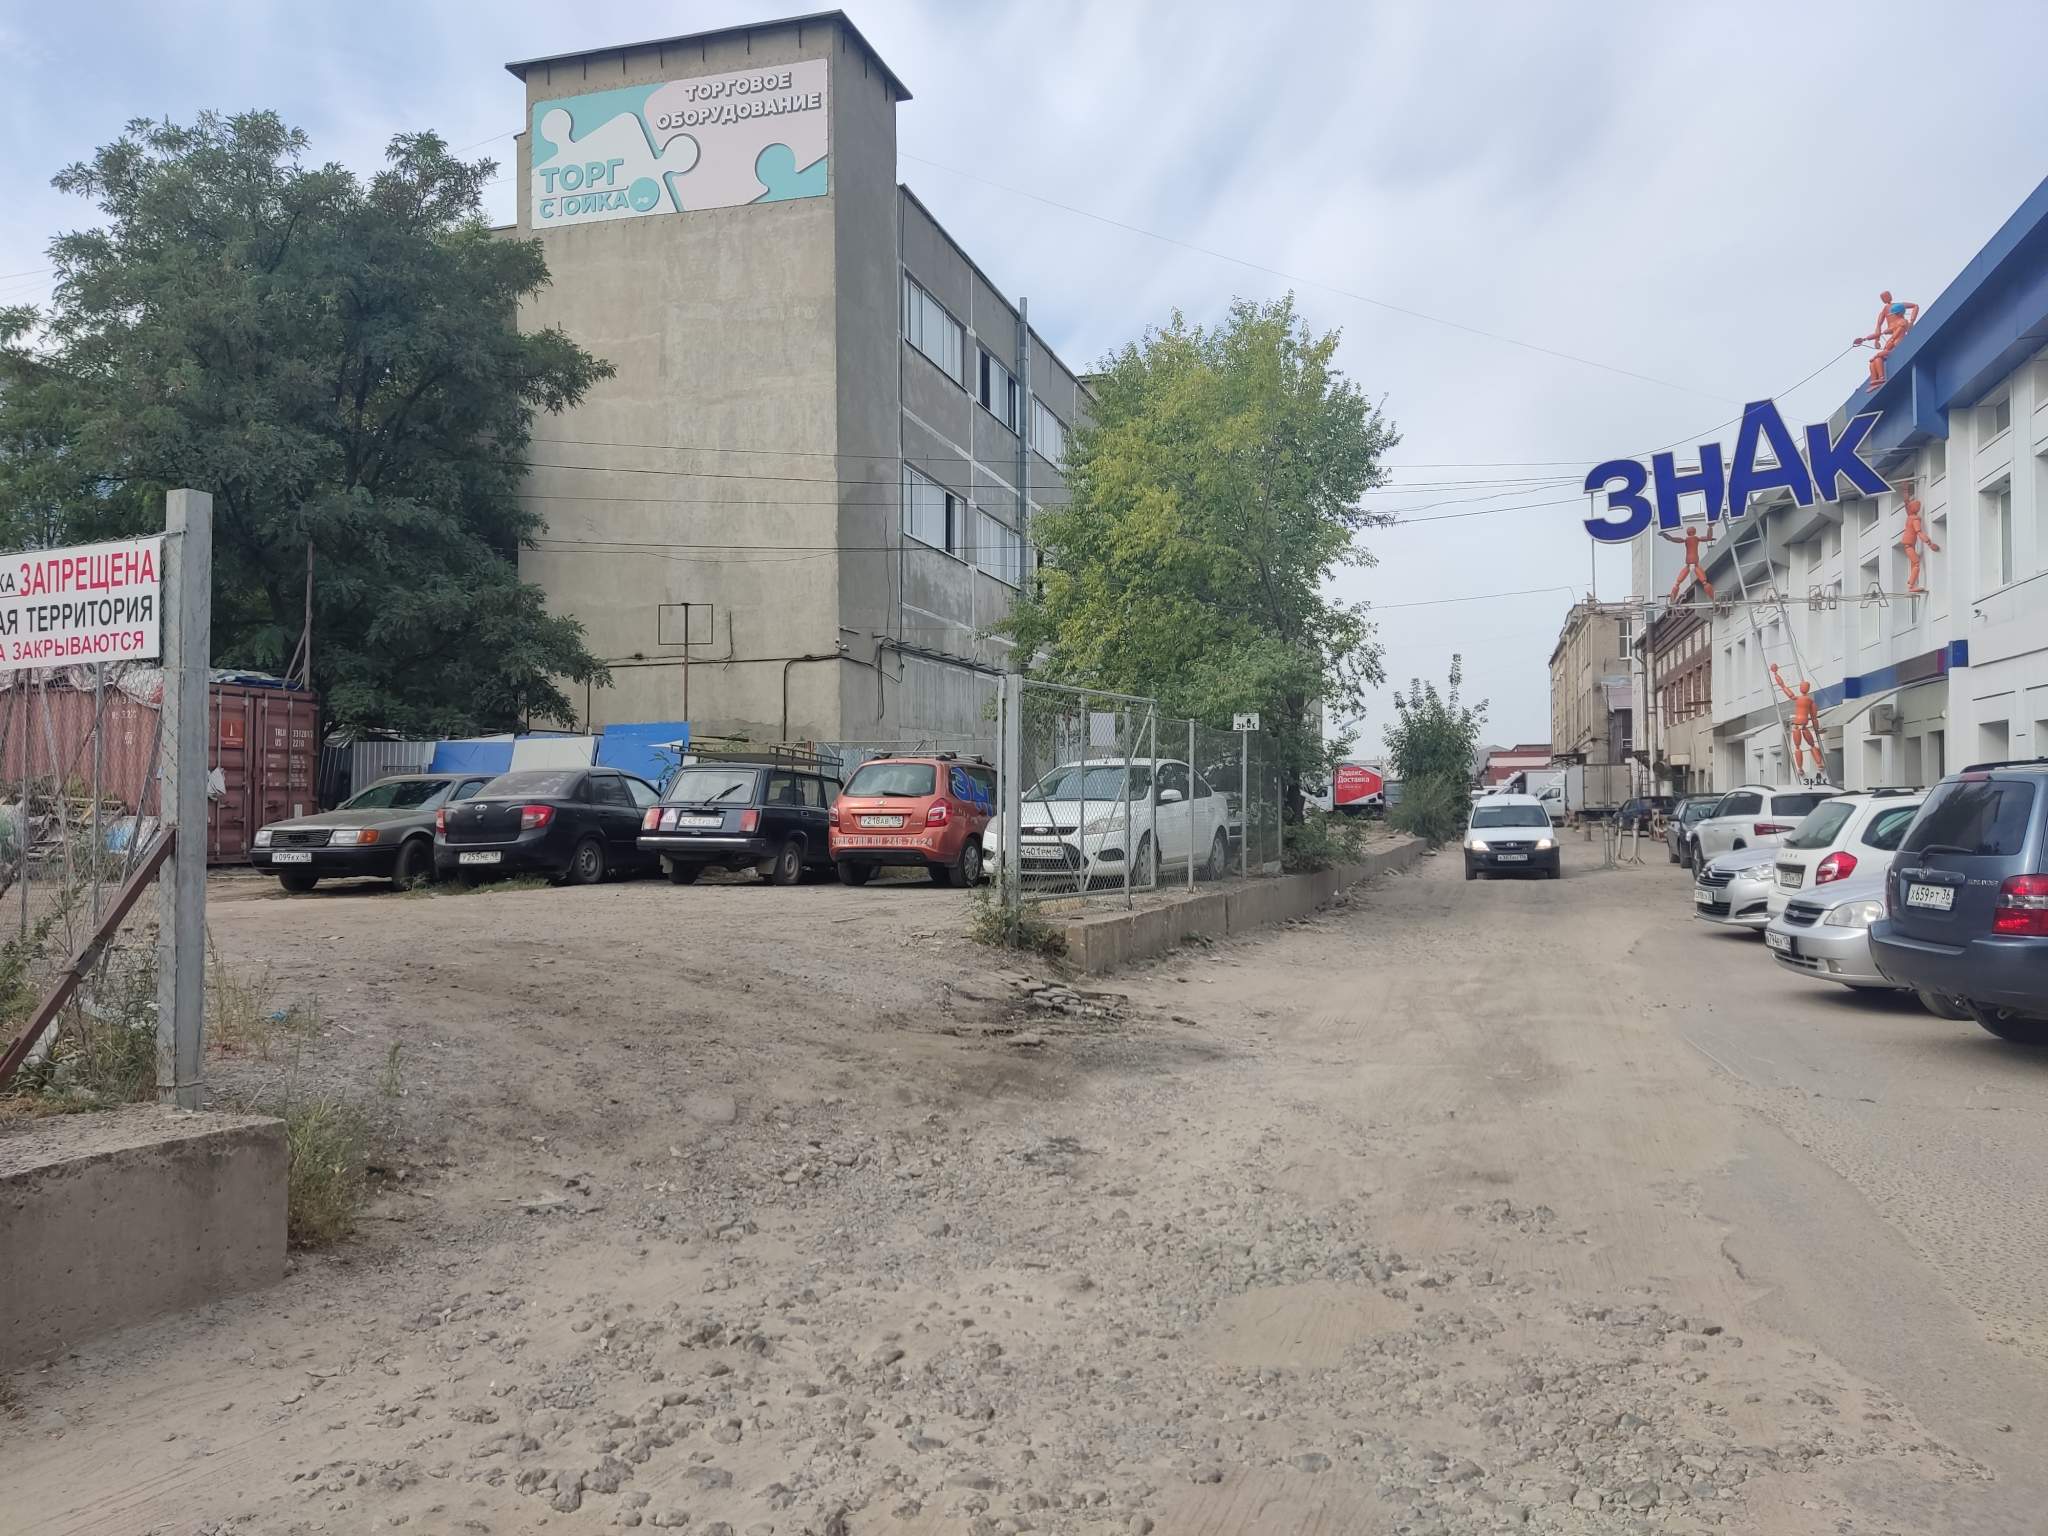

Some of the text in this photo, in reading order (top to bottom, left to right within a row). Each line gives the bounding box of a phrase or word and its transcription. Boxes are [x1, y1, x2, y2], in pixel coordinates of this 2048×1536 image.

[685, 72, 792, 101] ТОРГОВОЕ
[656, 92, 822, 130] ОБОРУДОВАНИЕ
[540, 159, 624, 193] ТОРГ
[1583, 398, 1895, 544] ЗНАК
[20, 550, 156, 597] ЗАПРЕЩЕНА
[26, 595, 153, 633] ТЕРРИТОРИЯ
[12, 631, 144, 661] ЗАКРЫВАЮТСЯ
